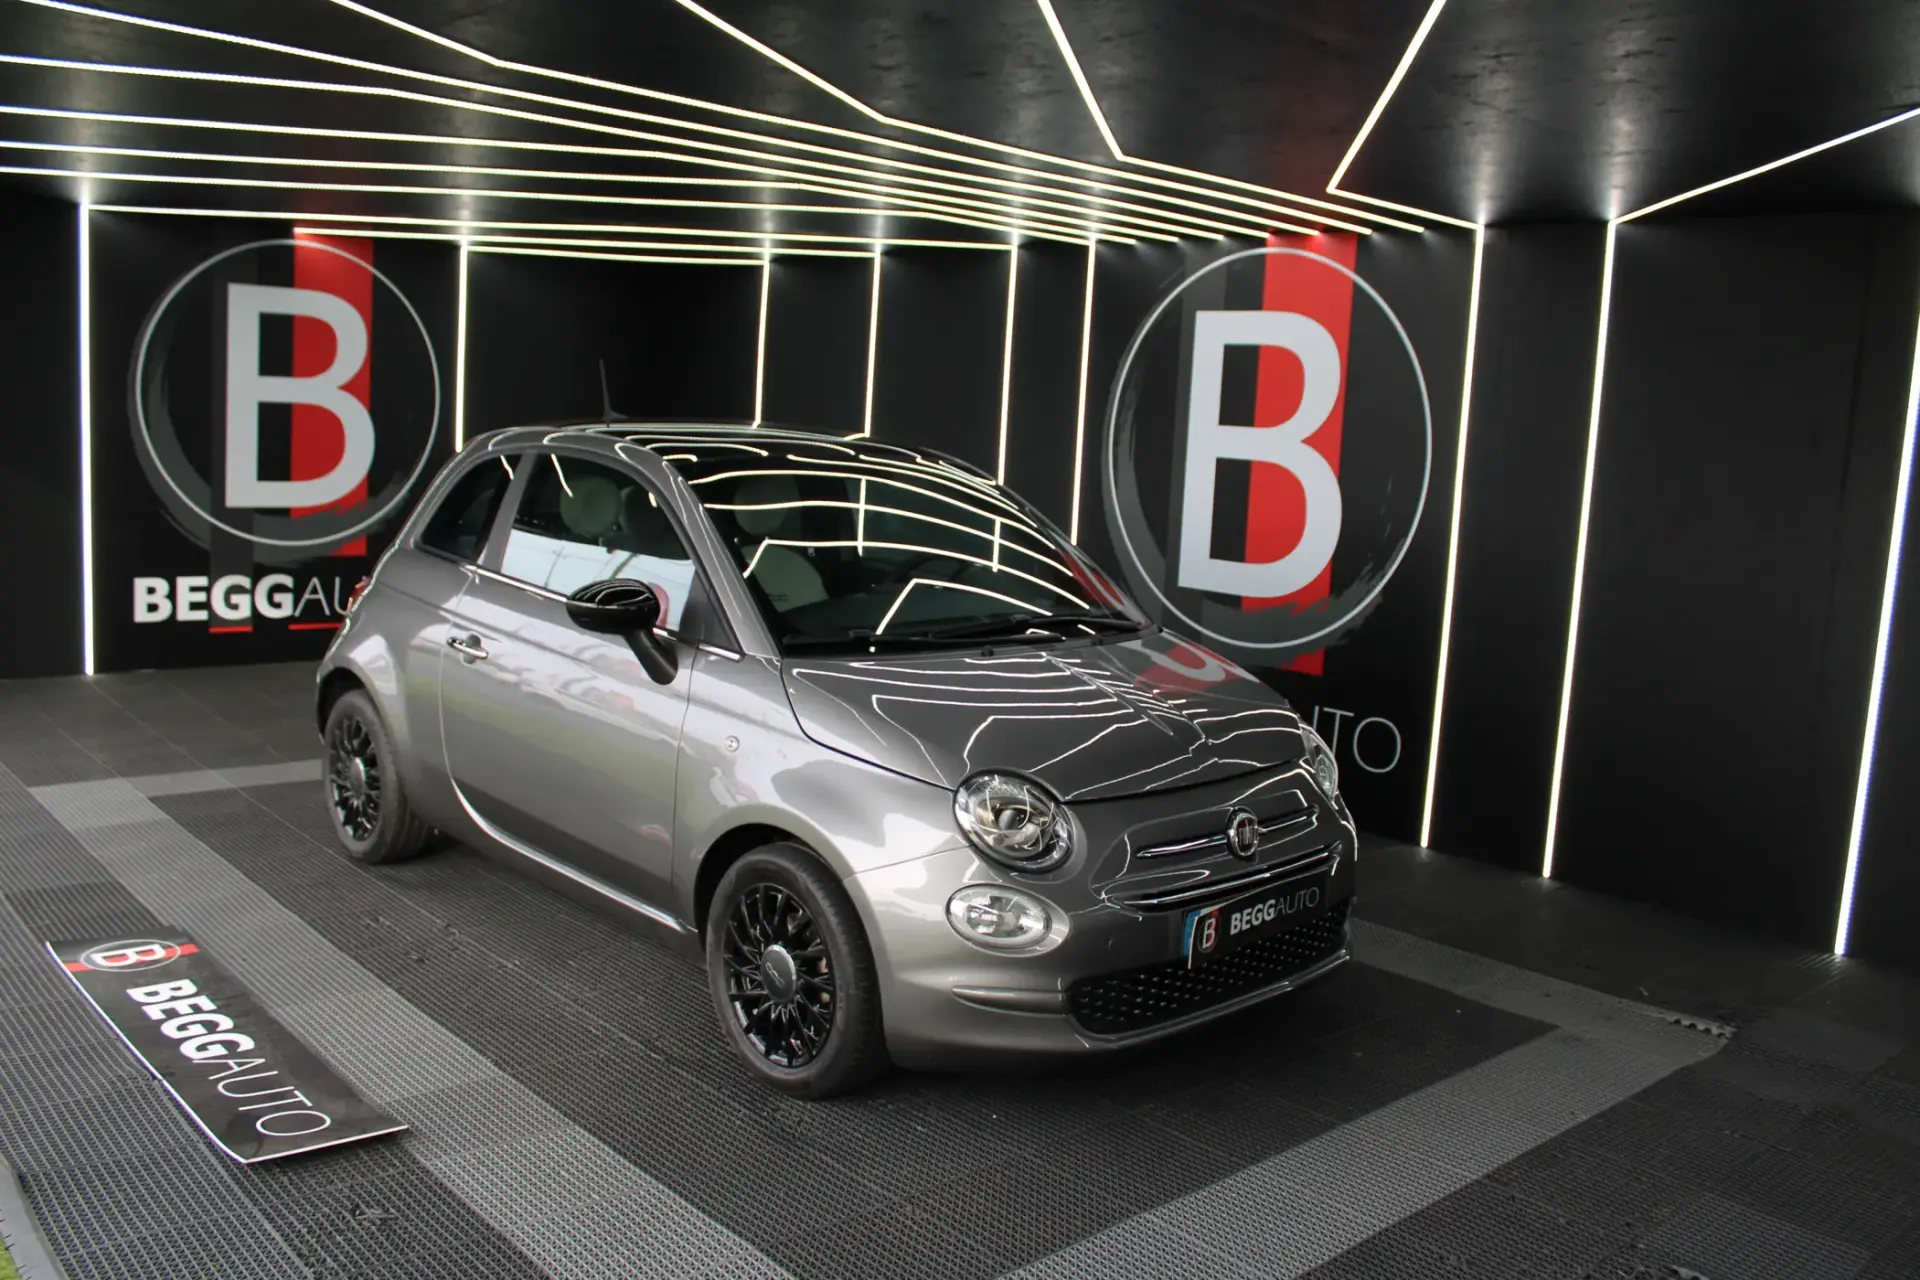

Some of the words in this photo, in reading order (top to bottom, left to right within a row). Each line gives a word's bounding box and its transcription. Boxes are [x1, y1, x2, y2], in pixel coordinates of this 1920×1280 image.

[225, 282, 375, 508] B
[1178, 310, 1342, 598] B
[91, 943, 167, 967] B
[1202, 918, 1216, 949] B
[1230, 887, 1320, 935] BEGGAUTO
[126, 979, 331, 1136] BEGGAUTO
